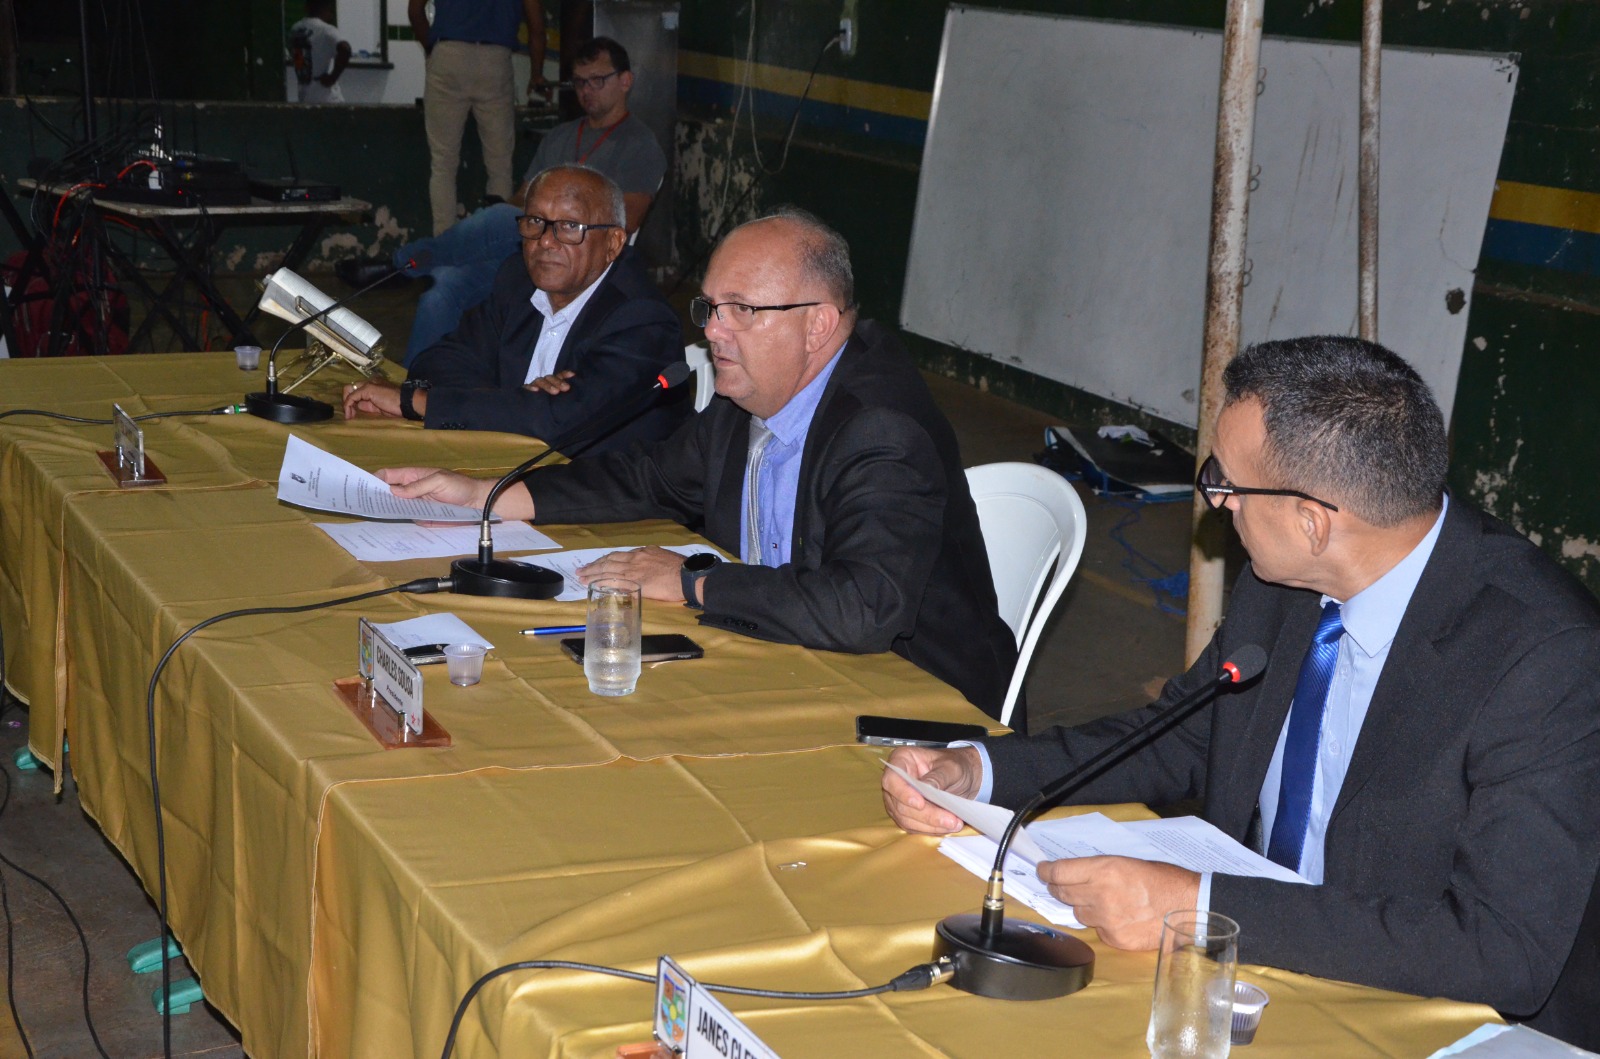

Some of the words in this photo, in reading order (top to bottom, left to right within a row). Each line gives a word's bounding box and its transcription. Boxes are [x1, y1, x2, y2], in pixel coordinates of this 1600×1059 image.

[376, 646, 397, 682] CHARLES
[398, 667, 413, 699] SOUSA
[697, 1006, 729, 1057] JANES
[731, 1037, 758, 1059] CL
